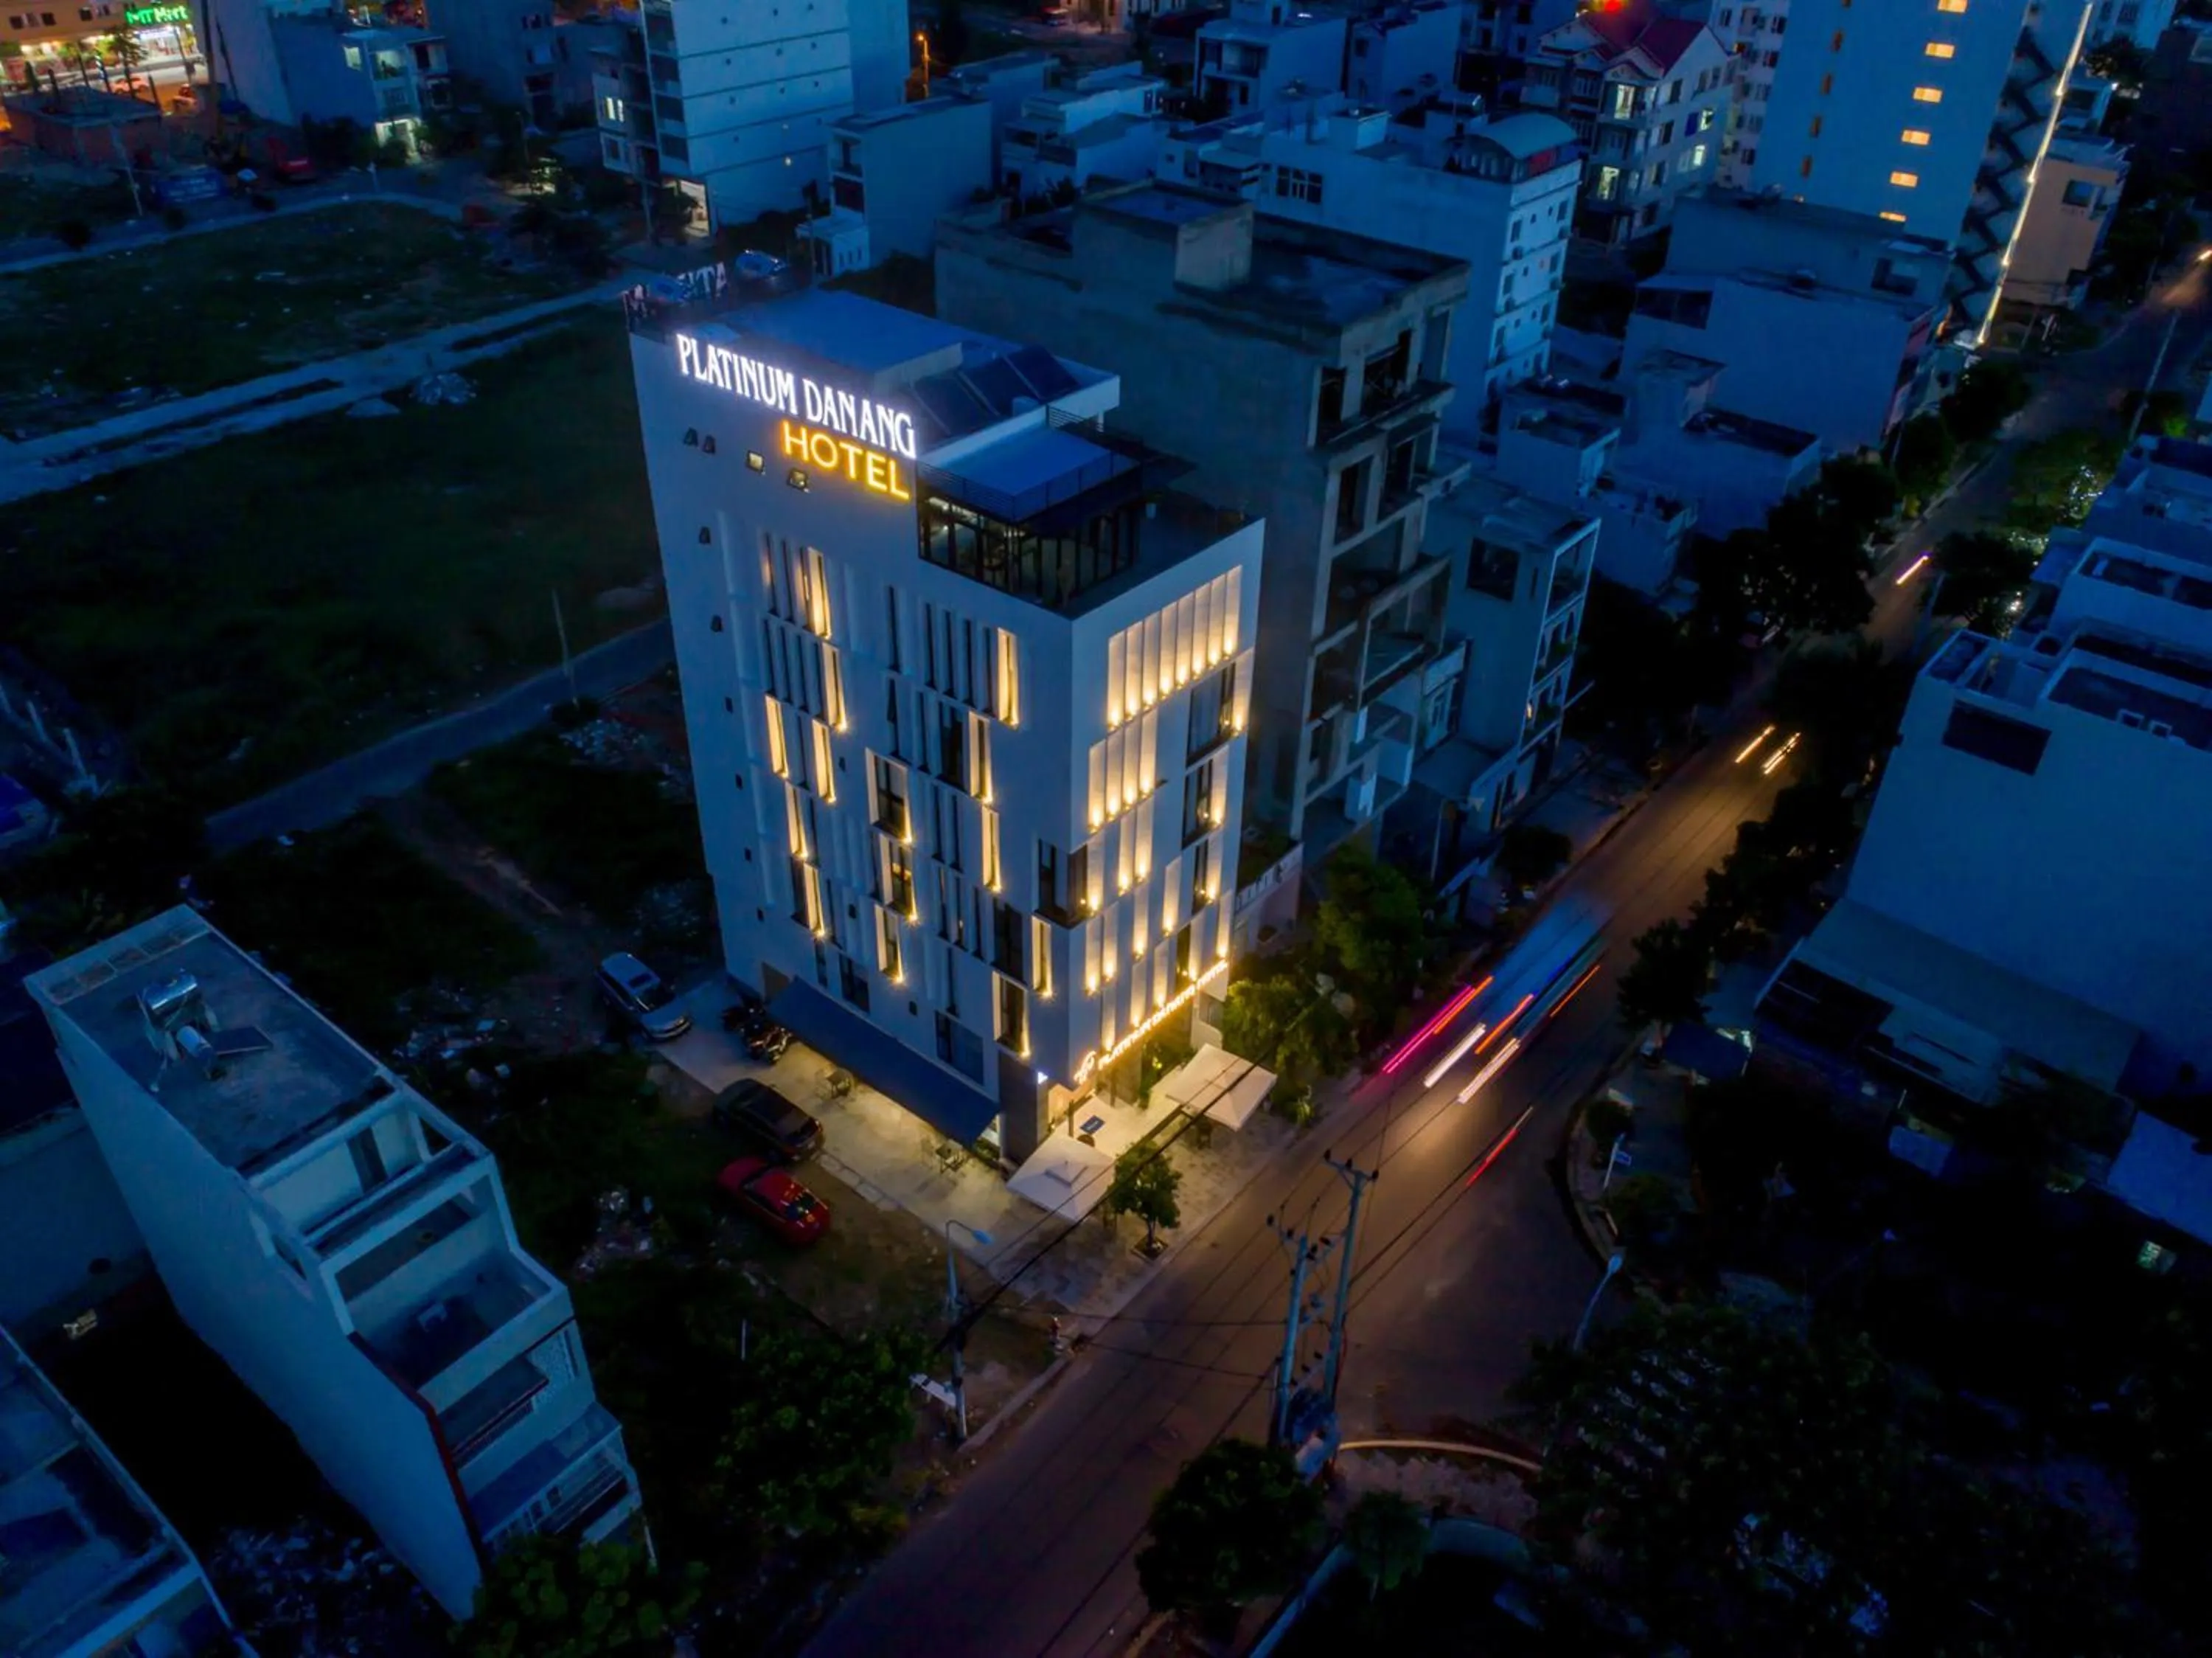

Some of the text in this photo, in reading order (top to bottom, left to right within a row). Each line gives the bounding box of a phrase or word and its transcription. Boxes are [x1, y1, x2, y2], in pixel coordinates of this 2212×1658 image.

[676, 333, 917, 459] PLATINUM DANANG
[782, 420, 910, 500] HOTEL
